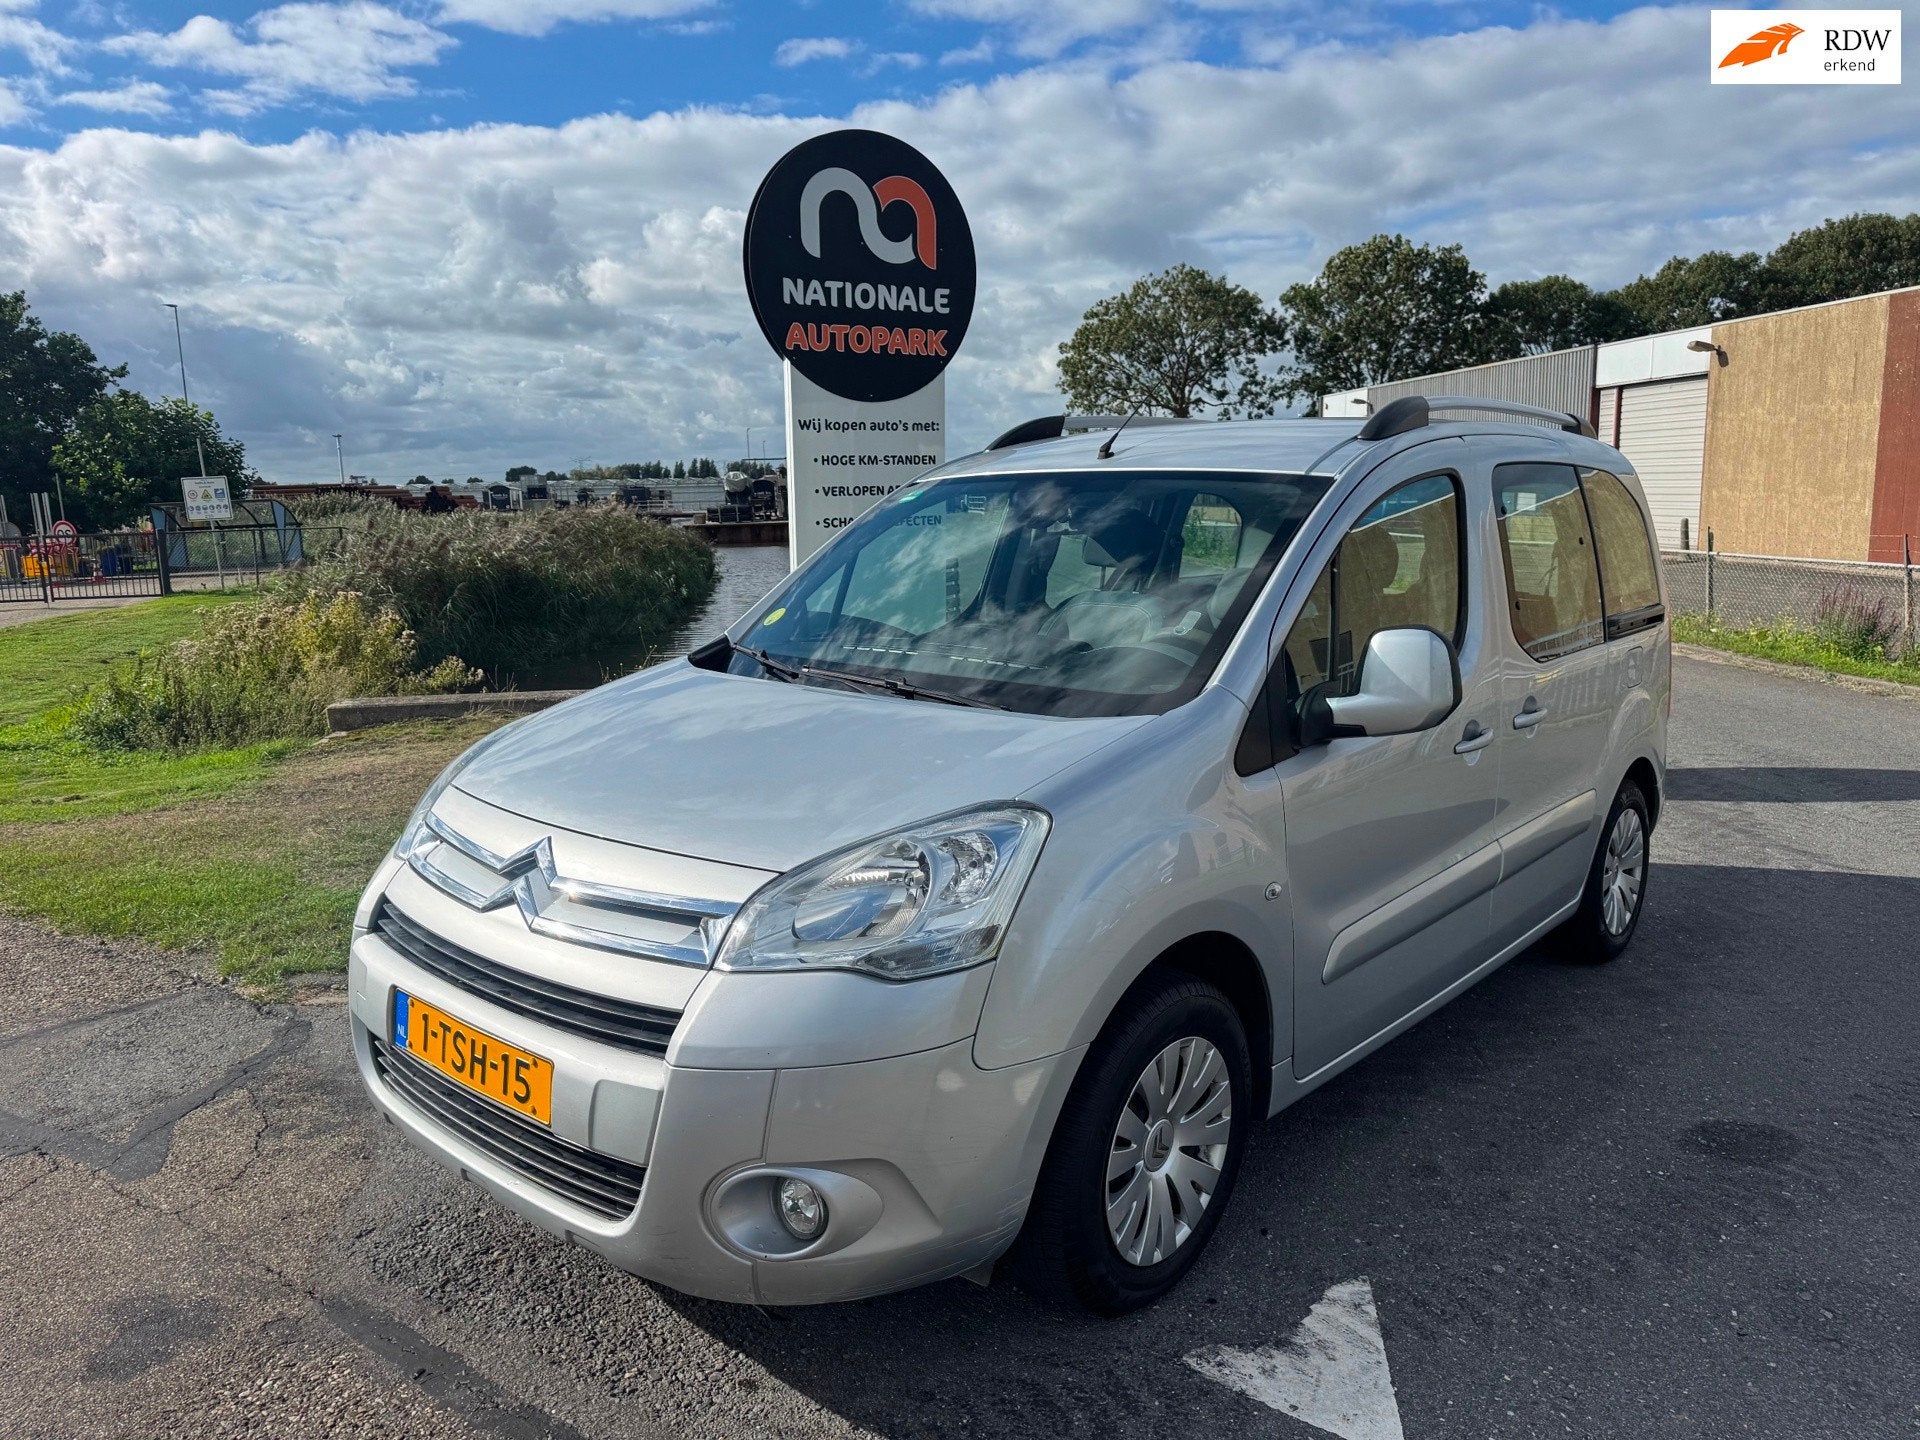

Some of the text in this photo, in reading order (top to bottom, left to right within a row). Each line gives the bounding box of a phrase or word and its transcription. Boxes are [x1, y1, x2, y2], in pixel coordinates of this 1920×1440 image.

[782, 276, 950, 314] NATIONALE
[785, 322, 948, 356] AUTOPARK
[798, 419, 940, 433] Wij kopen auto's met:
[821, 454, 936, 466] HOGE KM-STANDEN
[822, 485, 885, 497] VERLOPEN
[822, 517, 858, 529] SCHA
[397, 1023, 407, 1039] NL
[421, 1013, 532, 1104] 1-TSH-15
